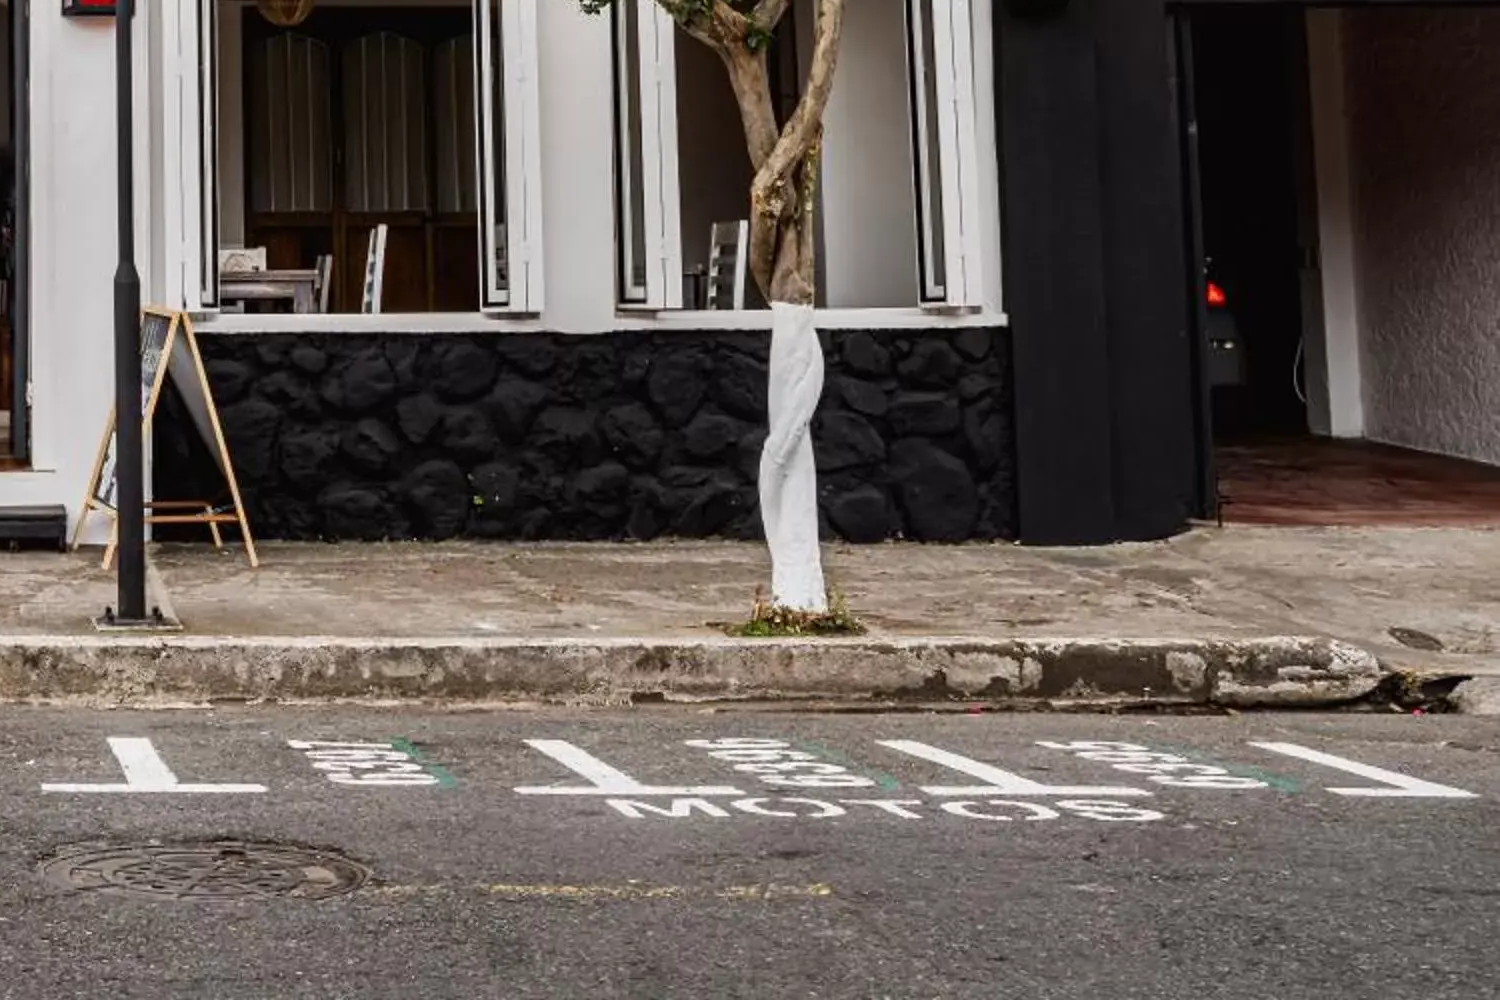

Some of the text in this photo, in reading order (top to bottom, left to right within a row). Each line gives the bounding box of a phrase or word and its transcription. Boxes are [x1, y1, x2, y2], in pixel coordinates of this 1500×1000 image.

[684, 736, 878, 788] 6396
[1035, 740, 1270, 789] 6395
[605, 797, 1167, 822] MOTOS
